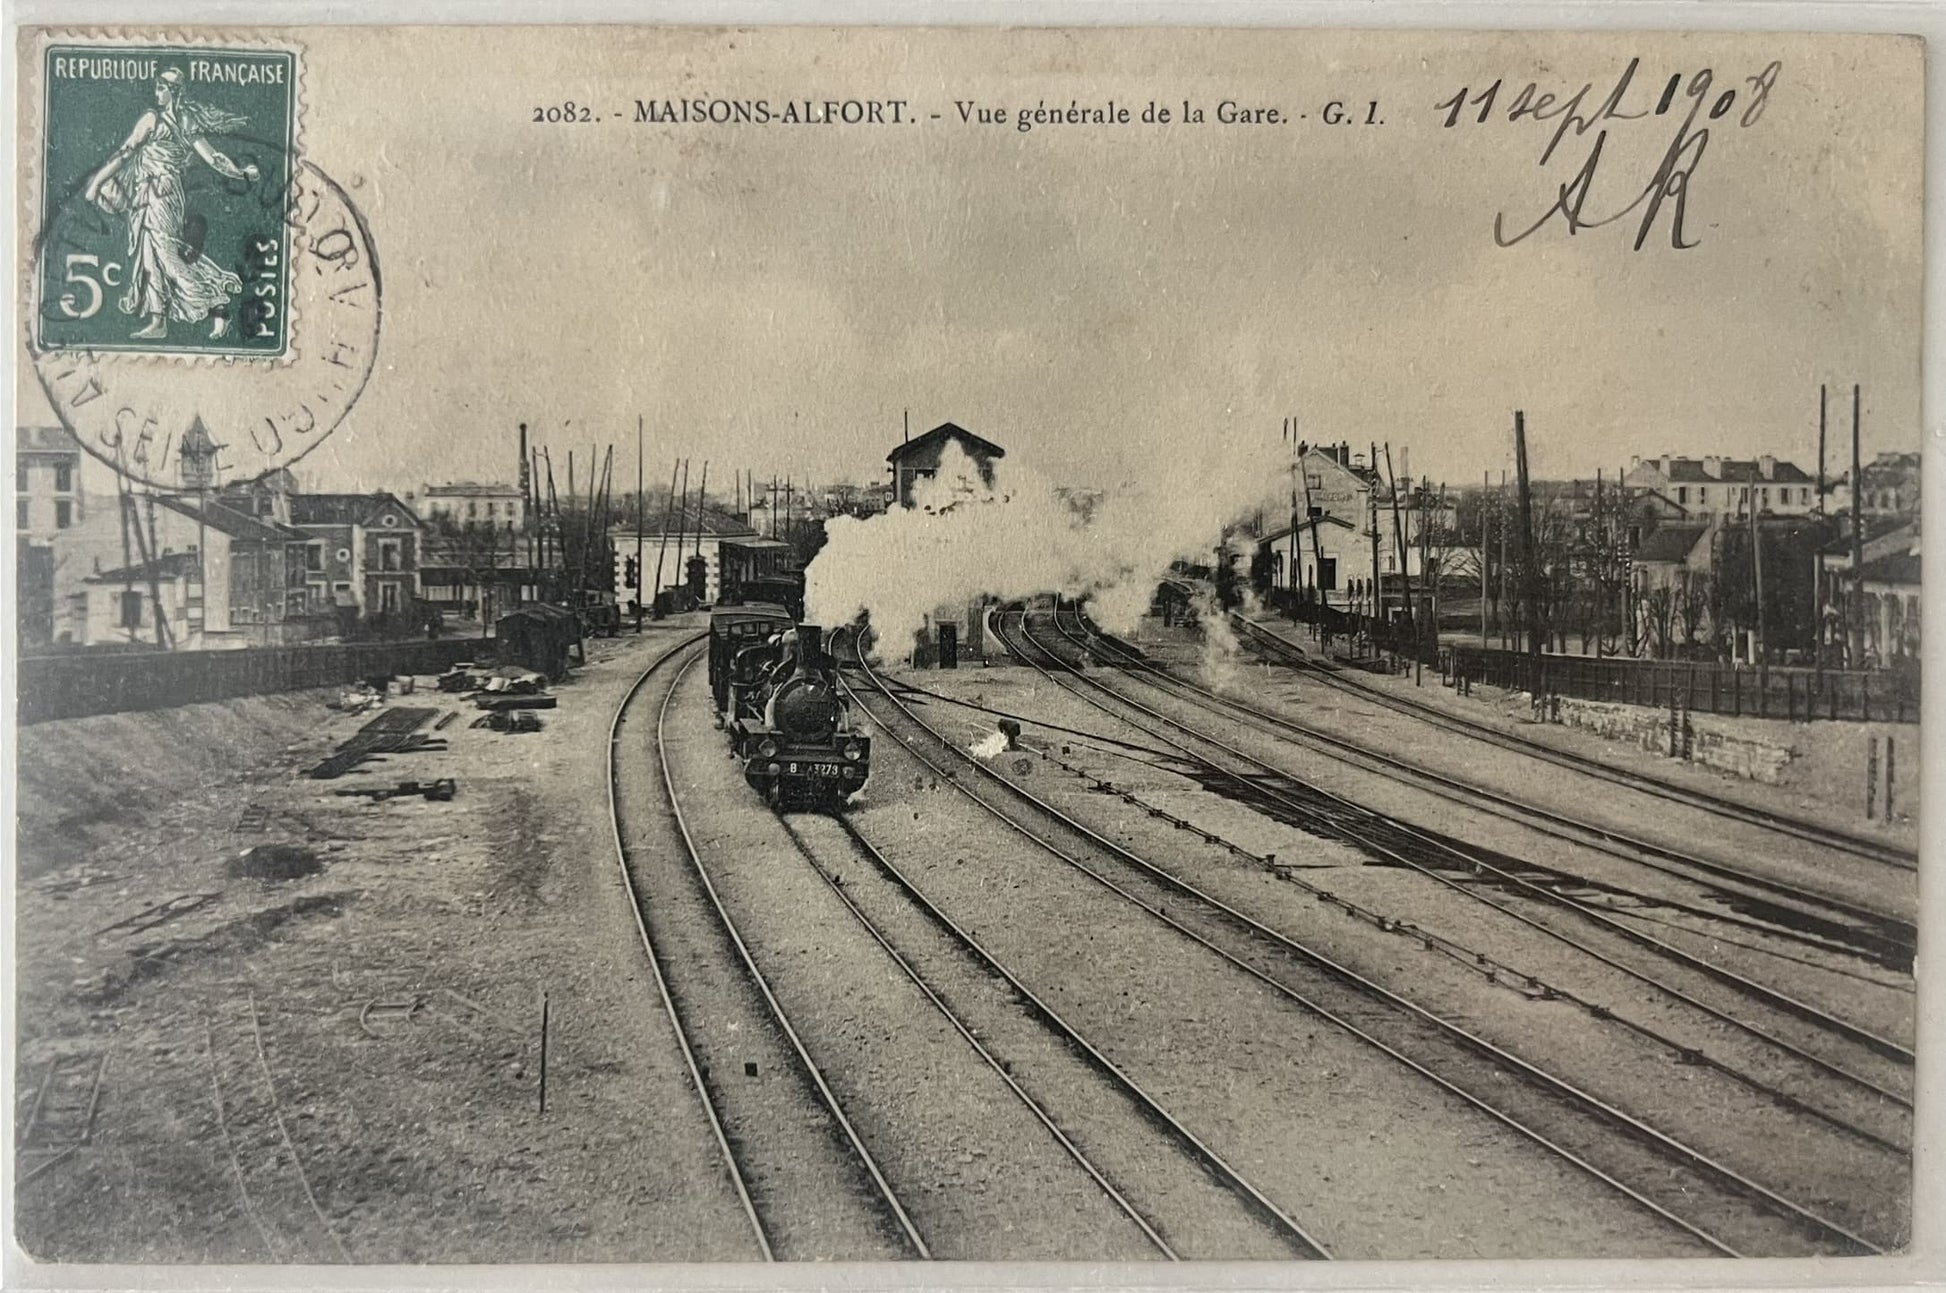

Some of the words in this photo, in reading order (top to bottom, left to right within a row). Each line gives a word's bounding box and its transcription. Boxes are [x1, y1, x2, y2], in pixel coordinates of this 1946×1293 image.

[190, 61, 284, 87] FRANÇAISE
[532, 101, 601, 123] 2082.
[634, 99, 916, 125] MAISONS-ALFORT.
[954, 101, 1007, 125] Vue
[1017, 100, 1131, 133] générale
[1141, 100, 1172, 125] de
[1182, 100, 1206, 125] la
[1216, 101, 1288, 125] Gare.
[1434, 79, 1502, 128] 11
[1655, 60, 1783, 142] 1908
